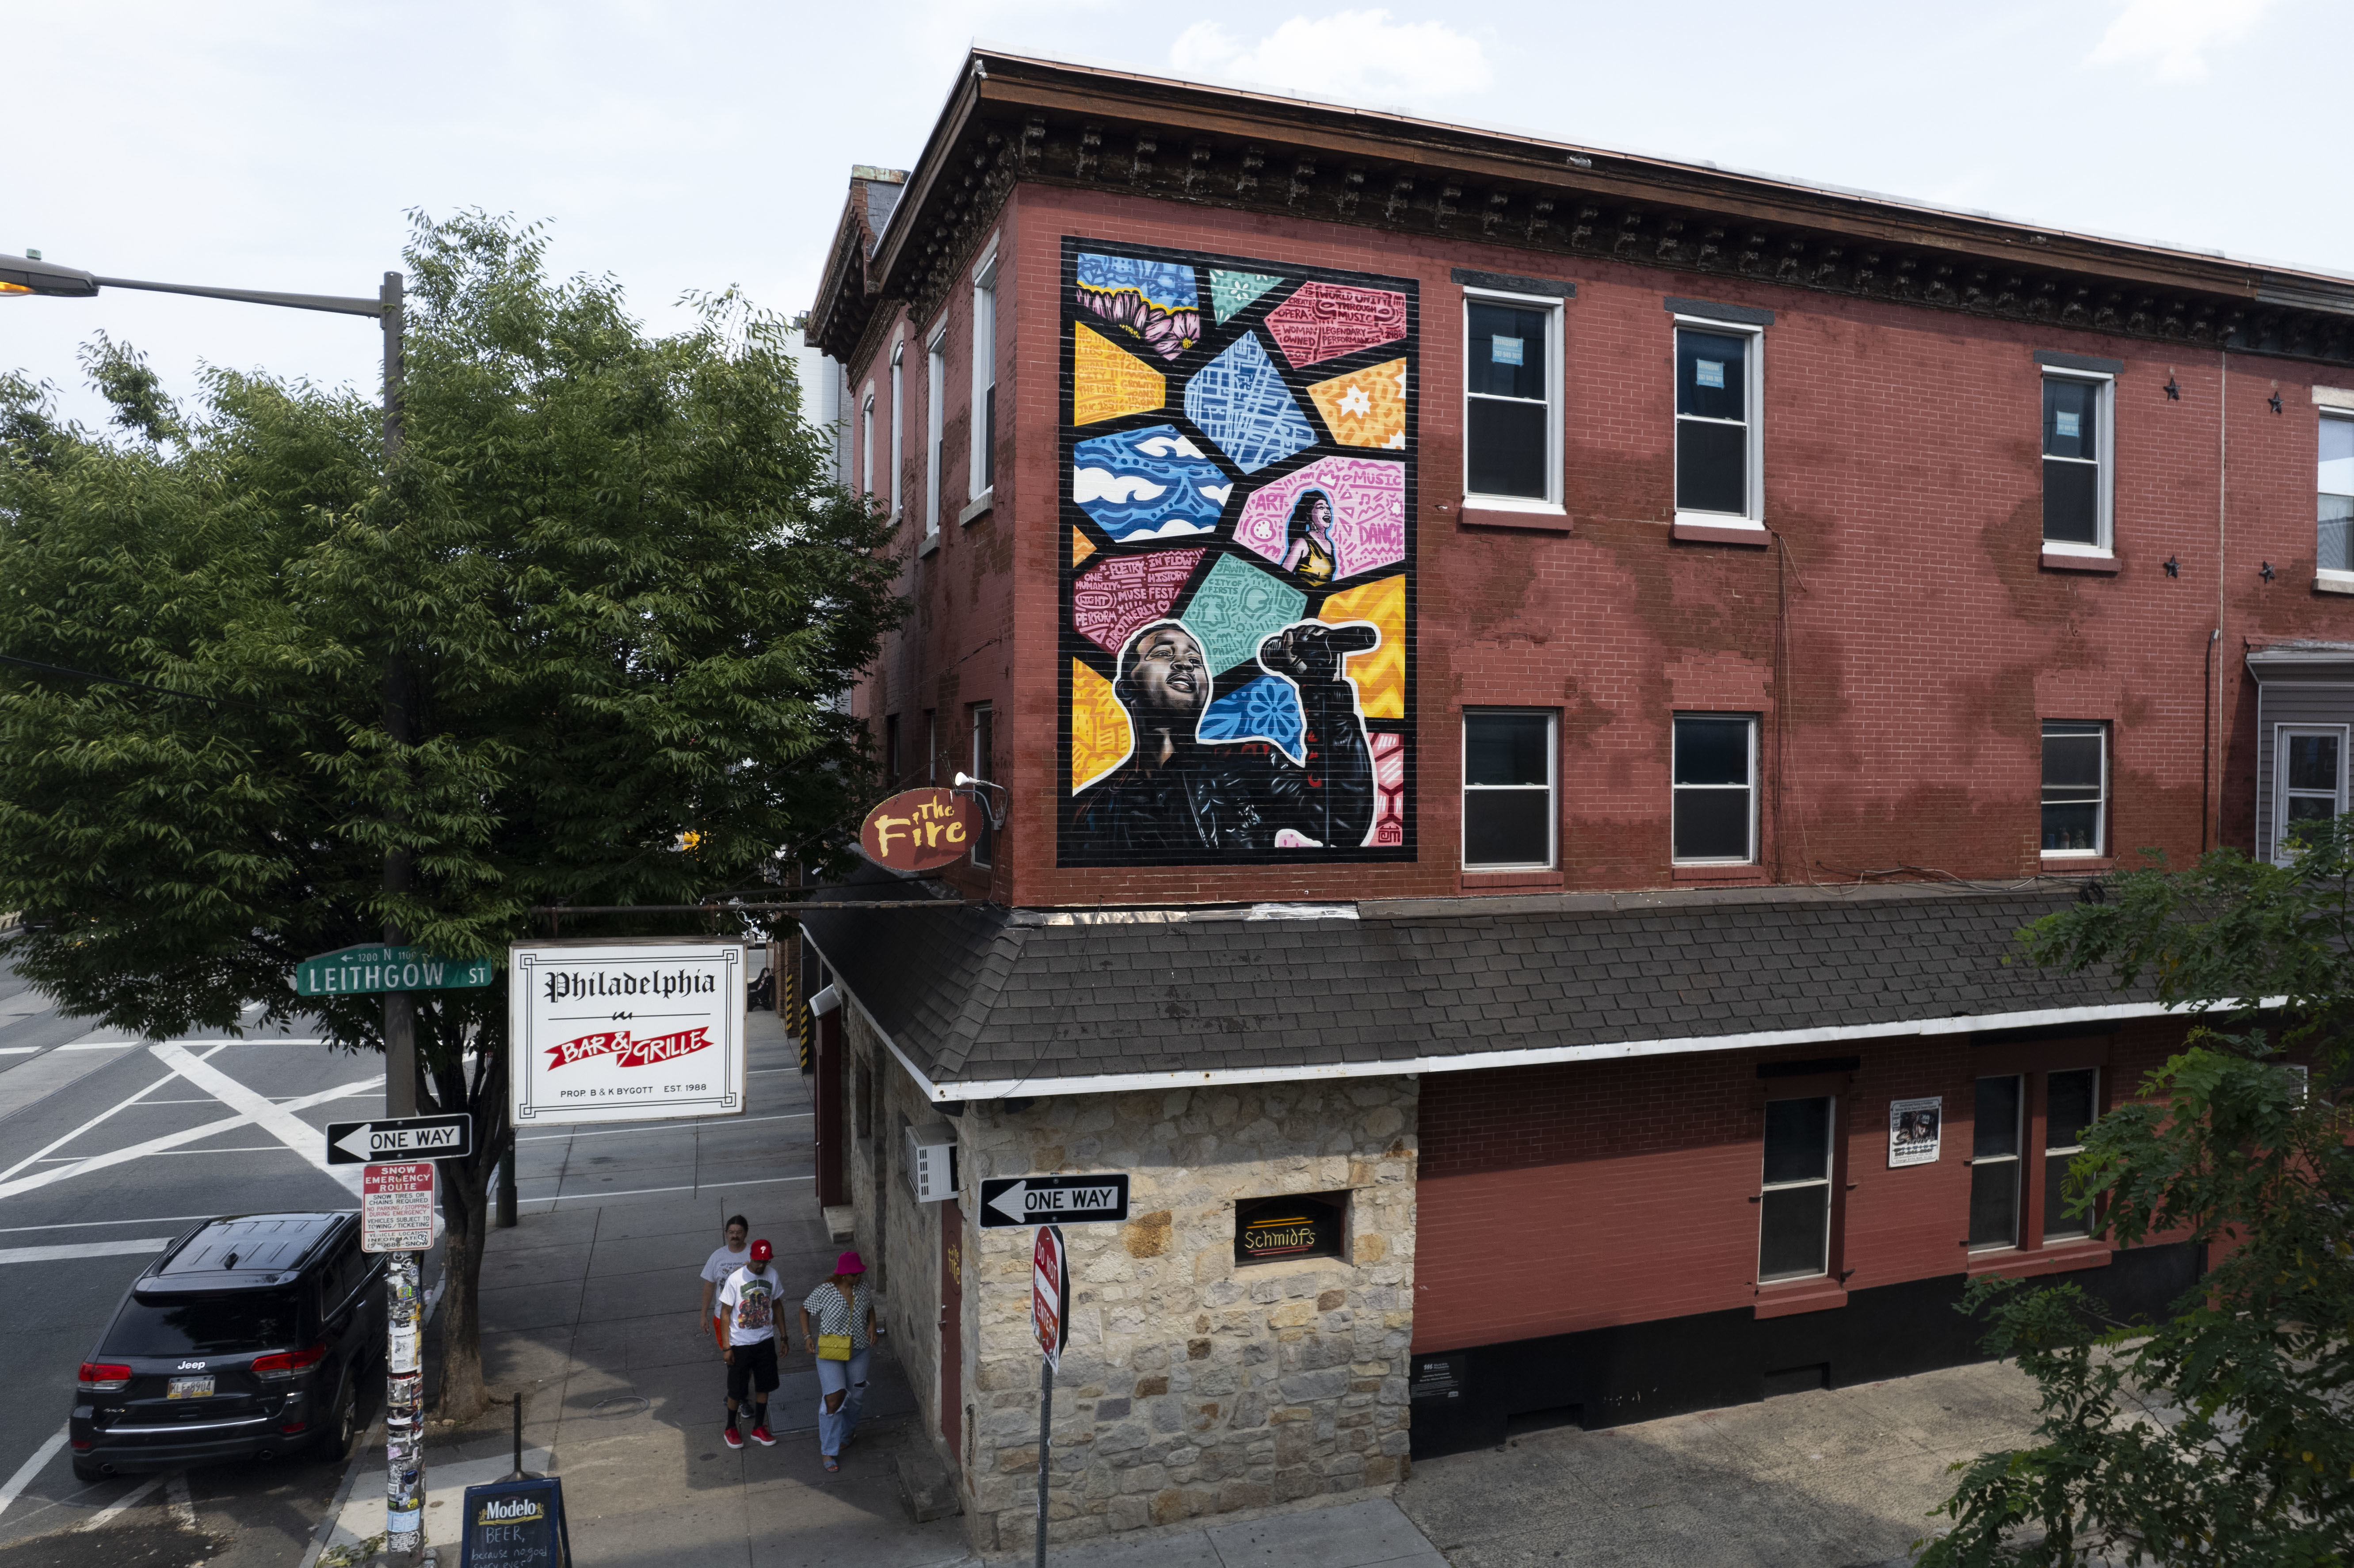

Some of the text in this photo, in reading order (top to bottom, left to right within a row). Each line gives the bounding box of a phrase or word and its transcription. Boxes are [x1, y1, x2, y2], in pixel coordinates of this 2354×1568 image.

[1288, 297, 1312, 305] CREATE
[1321, 288, 1388, 306] WORLD UNITY
[1335, 301, 1377, 313] THROUGH
[1278, 309, 1309, 320] OPERA
[1338, 310, 1373, 323] MUSIC
[1283, 325, 1317, 336] WOMAN
[1322, 327, 1366, 336] LEGENDARY
[1078, 334, 1092, 343] NO
[1283, 336, 1316, 347] OWNED
[1322, 335, 1381, 346] PERFORMANCES
[1495, 338, 1518, 347] WINDOW
[1078, 345, 1103, 355] LIBS
[1077, 383, 1118, 397] THE FIRE
[1353, 470, 1402, 486] MUSIC
[1255, 492, 1287, 511] ART
[1358, 522, 1404, 547] DANCE
[1109, 561, 1145, 575] POETRY
[1149, 556, 1192, 568] IN FLOW
[1217, 563, 1246, 574] JAWN
[1084, 572, 1103, 582] ONE
[1148, 571, 1187, 583] HISTORY
[1076, 581, 1118, 590] HUMANITY
[1080, 595, 1108, 606] LIGHT
[1118, 587, 1175, 602] MUSE FEST
[1076, 610, 1118, 626] PERFORM
[1106, 603, 1157, 650] BROTHERLY
[1213, 639, 1244, 657] PHILLY
[1214, 650, 1247, 673] PHILLY
[917, 795, 954, 820] The
[874, 812, 966, 857] Fire
[358, 953, 378, 962] 1200
[383, 949, 391, 961] N
[310, 962, 485, 992] LEITHGOW ST
[543, 969, 715, 1003] Philadelphia
[561, 1031, 702, 1064] BAR & GRILLE
[617, 1087, 653, 1095] BYGOTT
[370, 1128, 454, 1149] ONE WAY
[381, 1166, 416, 1175] SNOW
[365, 1174, 430, 1184] EMERGENCY
[380, 1183, 416, 1191] ROUTE
[1025, 1189, 1113, 1210] ONE WAY
[1038, 1241, 1057, 1284] DO NOT
[1037, 1297, 1053, 1338] ENTER
[177, 1361, 206, 1370] Jeep
[486, 1499, 536, 1519] Modelo
[486, 1526, 525, 1544] BEER,
[471, 1548, 508, 1560] because
[527, 1546, 547, 1562] good
